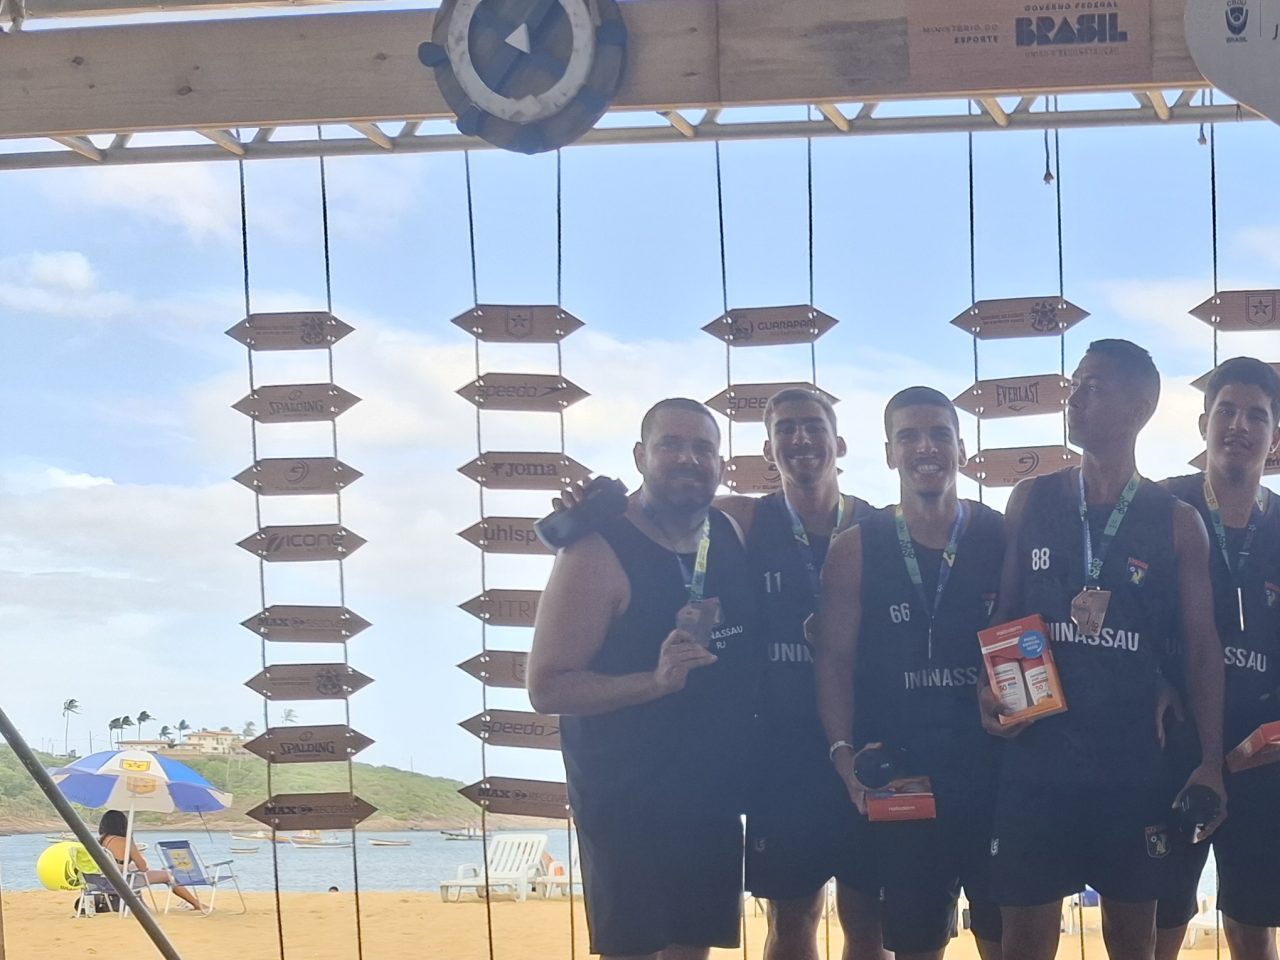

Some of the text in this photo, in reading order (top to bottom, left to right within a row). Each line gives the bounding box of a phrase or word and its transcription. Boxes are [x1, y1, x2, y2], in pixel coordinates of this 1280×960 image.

[1024, 4, 1071, 12] GOVERNO
[1015, 12, 1128, 47] BRASIL
[954, 35, 999, 44] ESPORTE
[757, 319, 817, 331] GUARAPARI
[477, 384, 537, 399] speedo
[996, 381, 1040, 407] EVERLAST
[268, 400, 325, 416] SPALDING
[727, 396, 770, 412] spee
[483, 523, 538, 545] uhlsp
[1032, 547, 1051, 571] 88
[763, 570, 783, 593] 11
[480, 599, 536, 618] CITR
[888, 602, 911, 624] 66
[768, 642, 815, 664] UNIN
[481, 720, 545, 736] speedo
[279, 740, 336, 755] SPALDING
[477, 788, 512, 799] MAX
[263, 805, 297, 816] MAX
